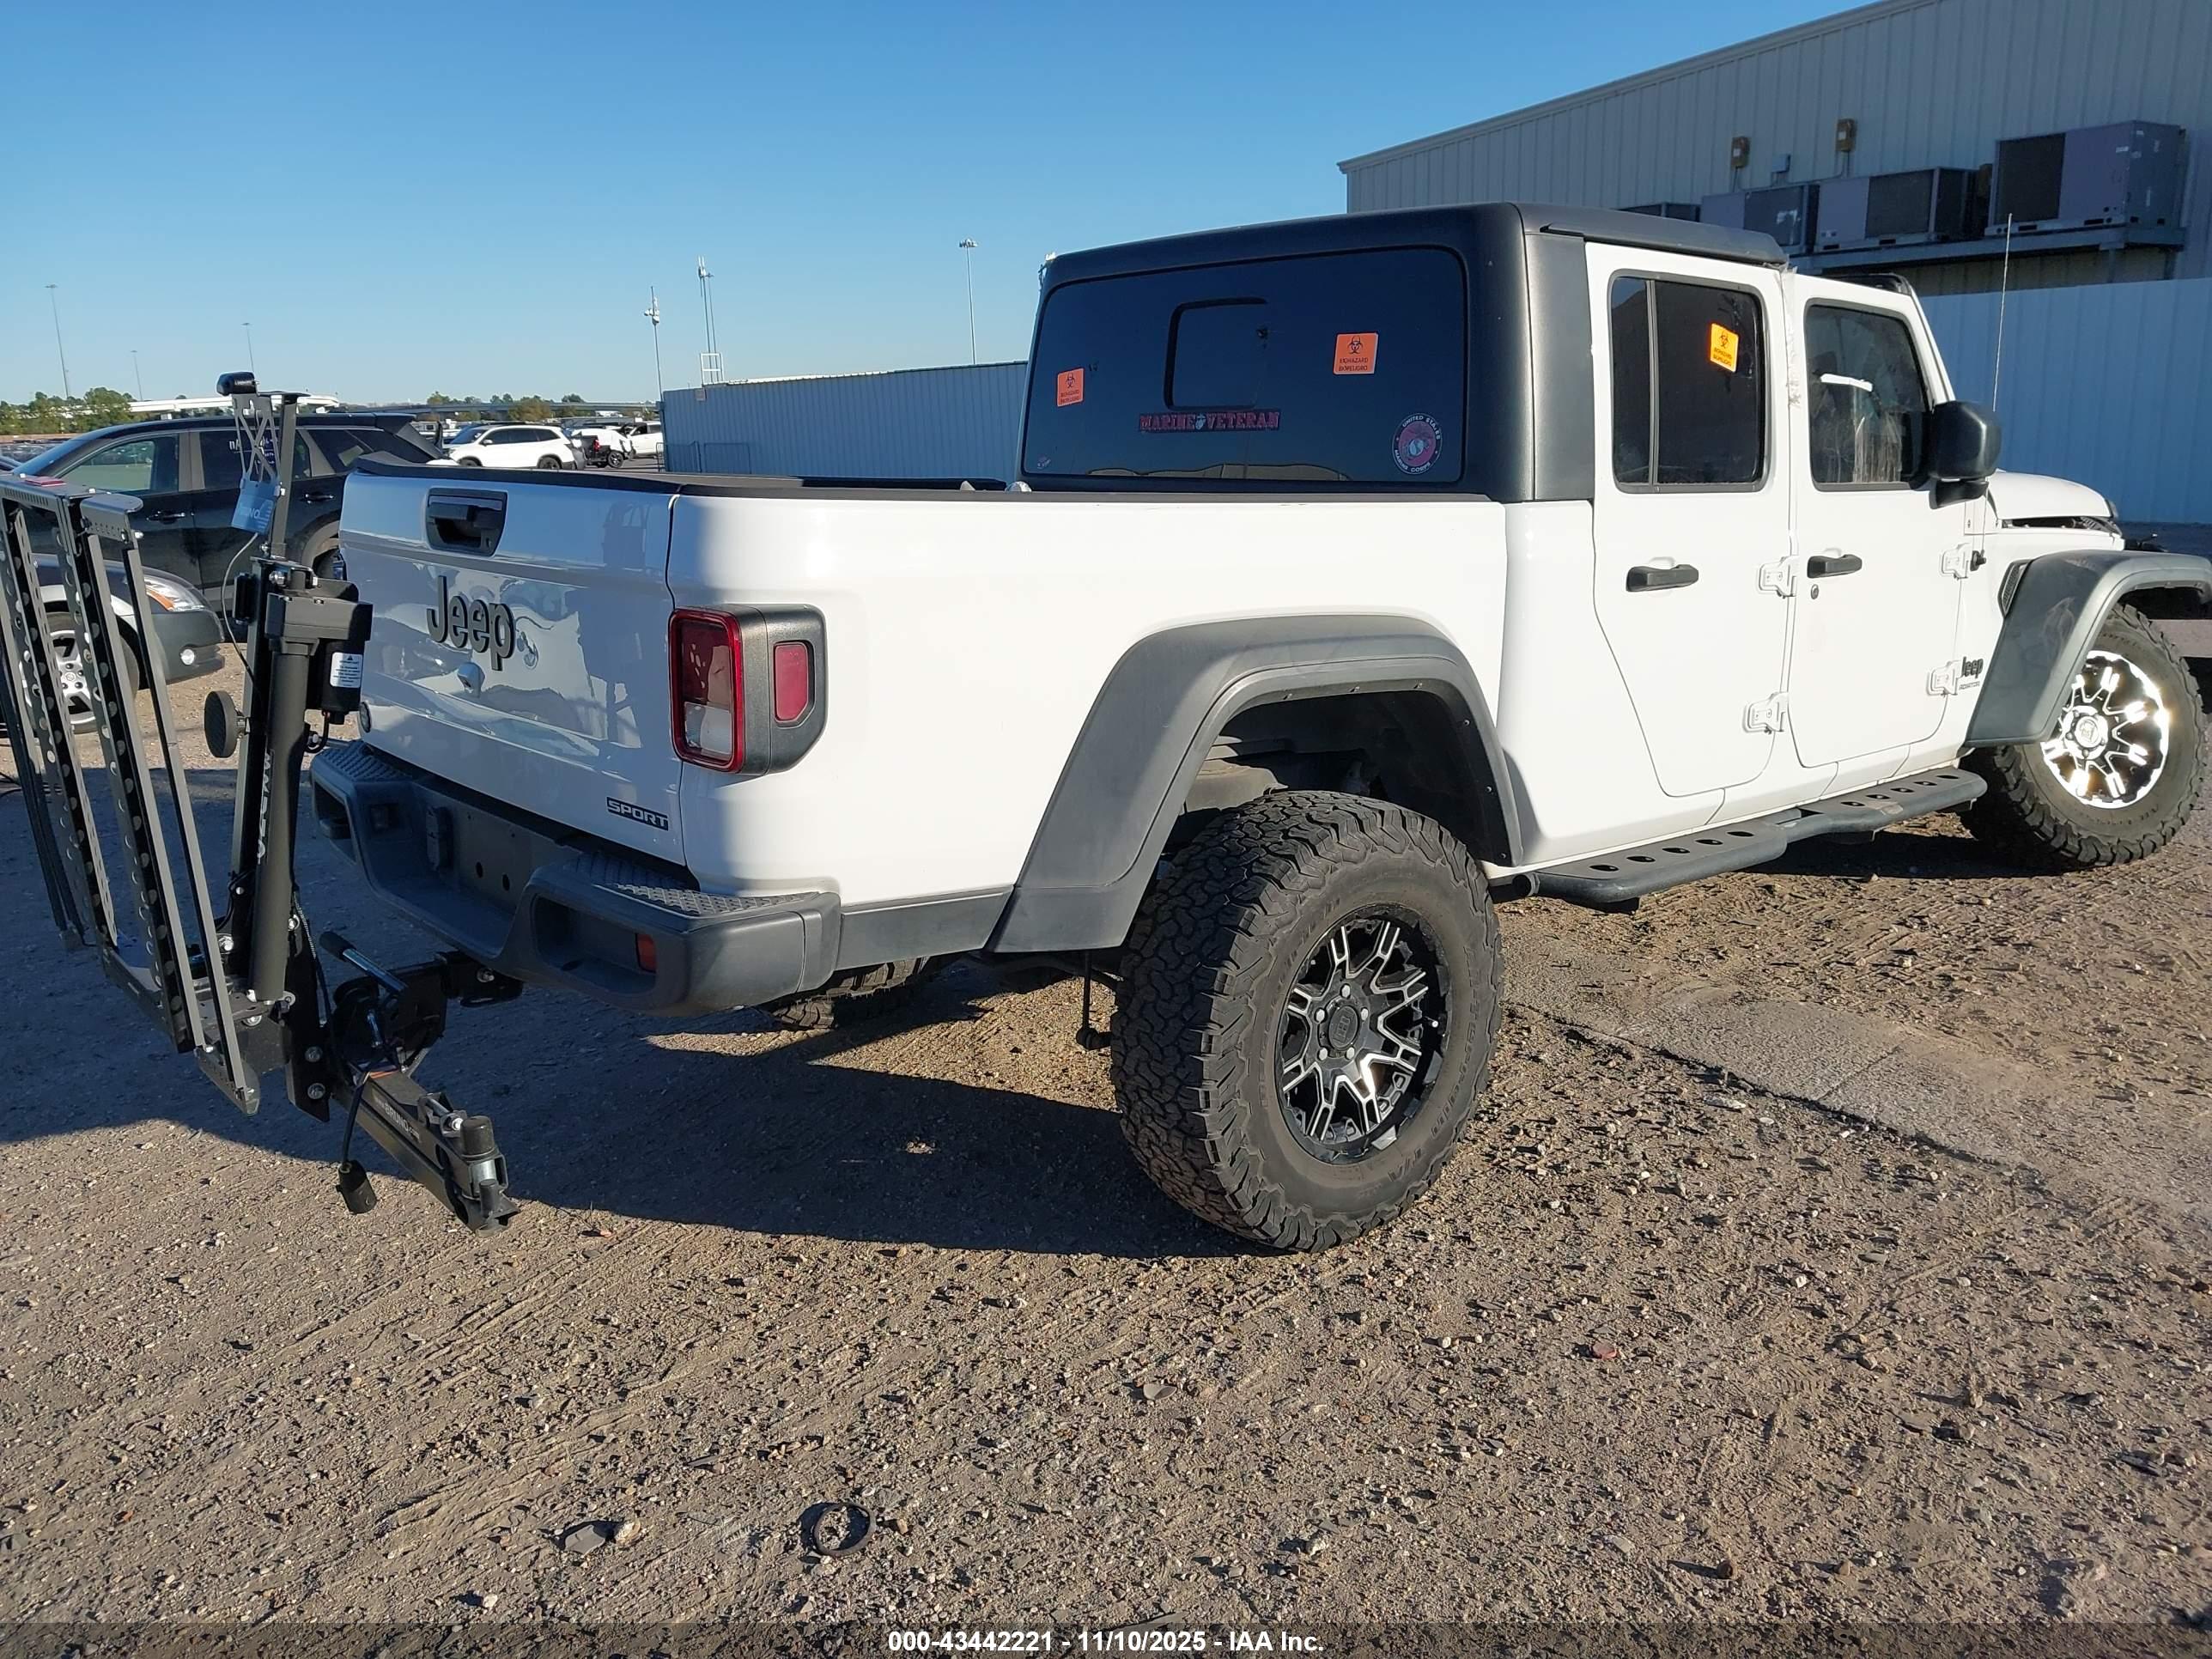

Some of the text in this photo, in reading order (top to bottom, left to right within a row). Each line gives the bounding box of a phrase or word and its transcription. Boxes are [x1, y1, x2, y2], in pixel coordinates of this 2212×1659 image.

[1139, 411, 1280, 431] MARINE VETERAN
[1402, 416, 1441, 440] UNITED STATES
[427, 575, 514, 672] Jeep
[1961, 656, 1984, 679] Jeep
[607, 799, 669, 827] SPORT
